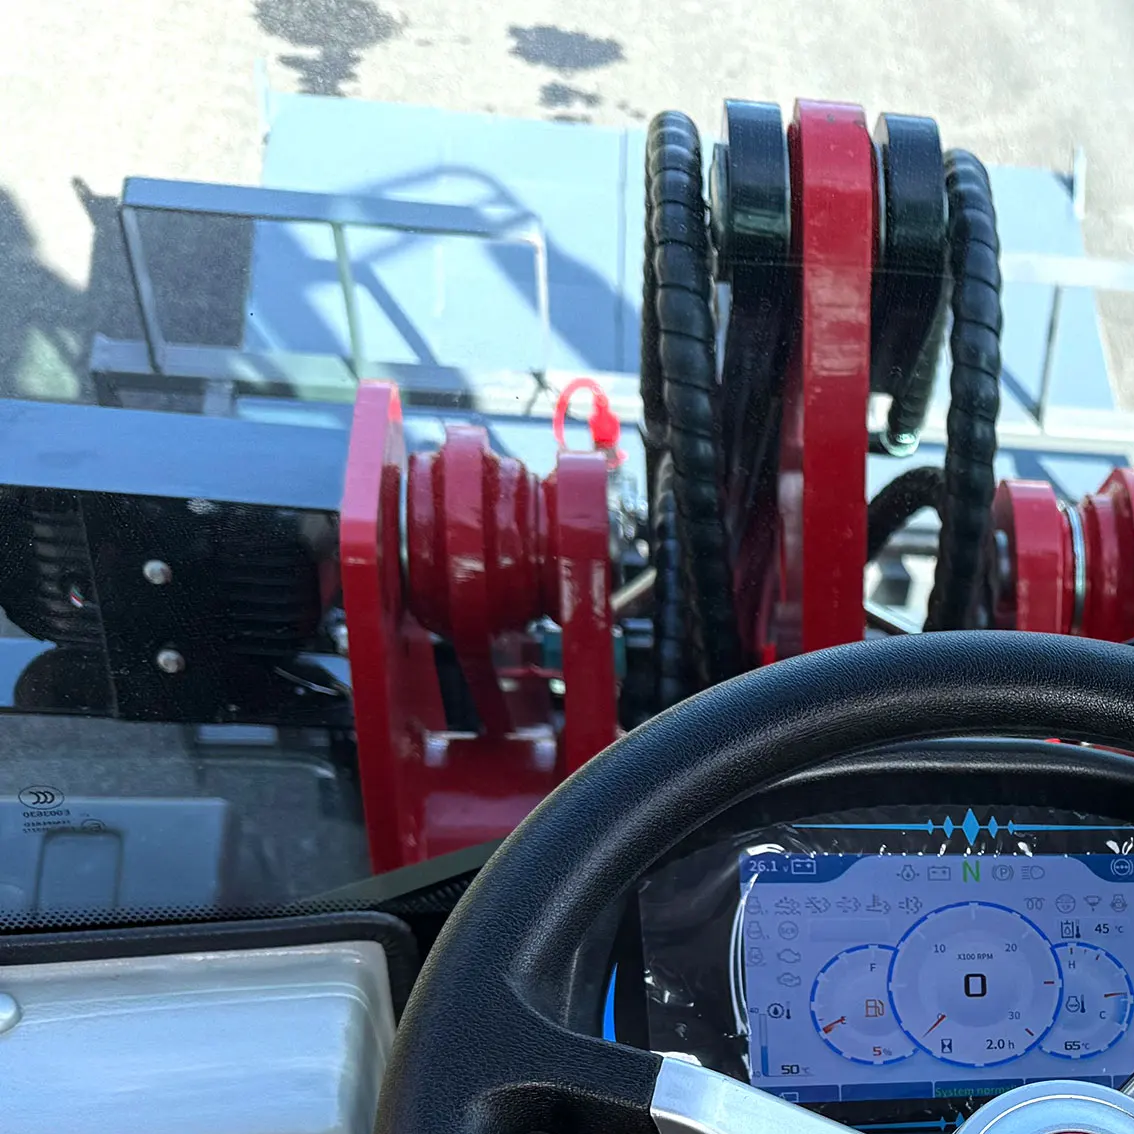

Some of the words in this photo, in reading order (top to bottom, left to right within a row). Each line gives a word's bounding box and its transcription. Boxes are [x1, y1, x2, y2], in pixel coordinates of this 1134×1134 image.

[749, 860, 778, 872] 26.1
[962, 860, 981, 883] N
[1094, 922, 1110, 934] 45
[934, 944, 946, 953] 10
[1005, 943, 1017, 953] 20
[869, 963, 877, 972] F
[1068, 960, 1076, 969] H
[964, 973, 987, 998] 0
[1008, 1011, 1021, 1020] 30
[1099, 1010, 1106, 1020] C
[986, 1039, 1005, 1050] 2.0
[1008, 1040, 1014, 1049] h
[1064, 1040, 1081, 1050] 65
[873, 1046, 882, 1056] 5
[781, 1064, 800, 1075] 50
[935, 1087, 973, 1098] System
